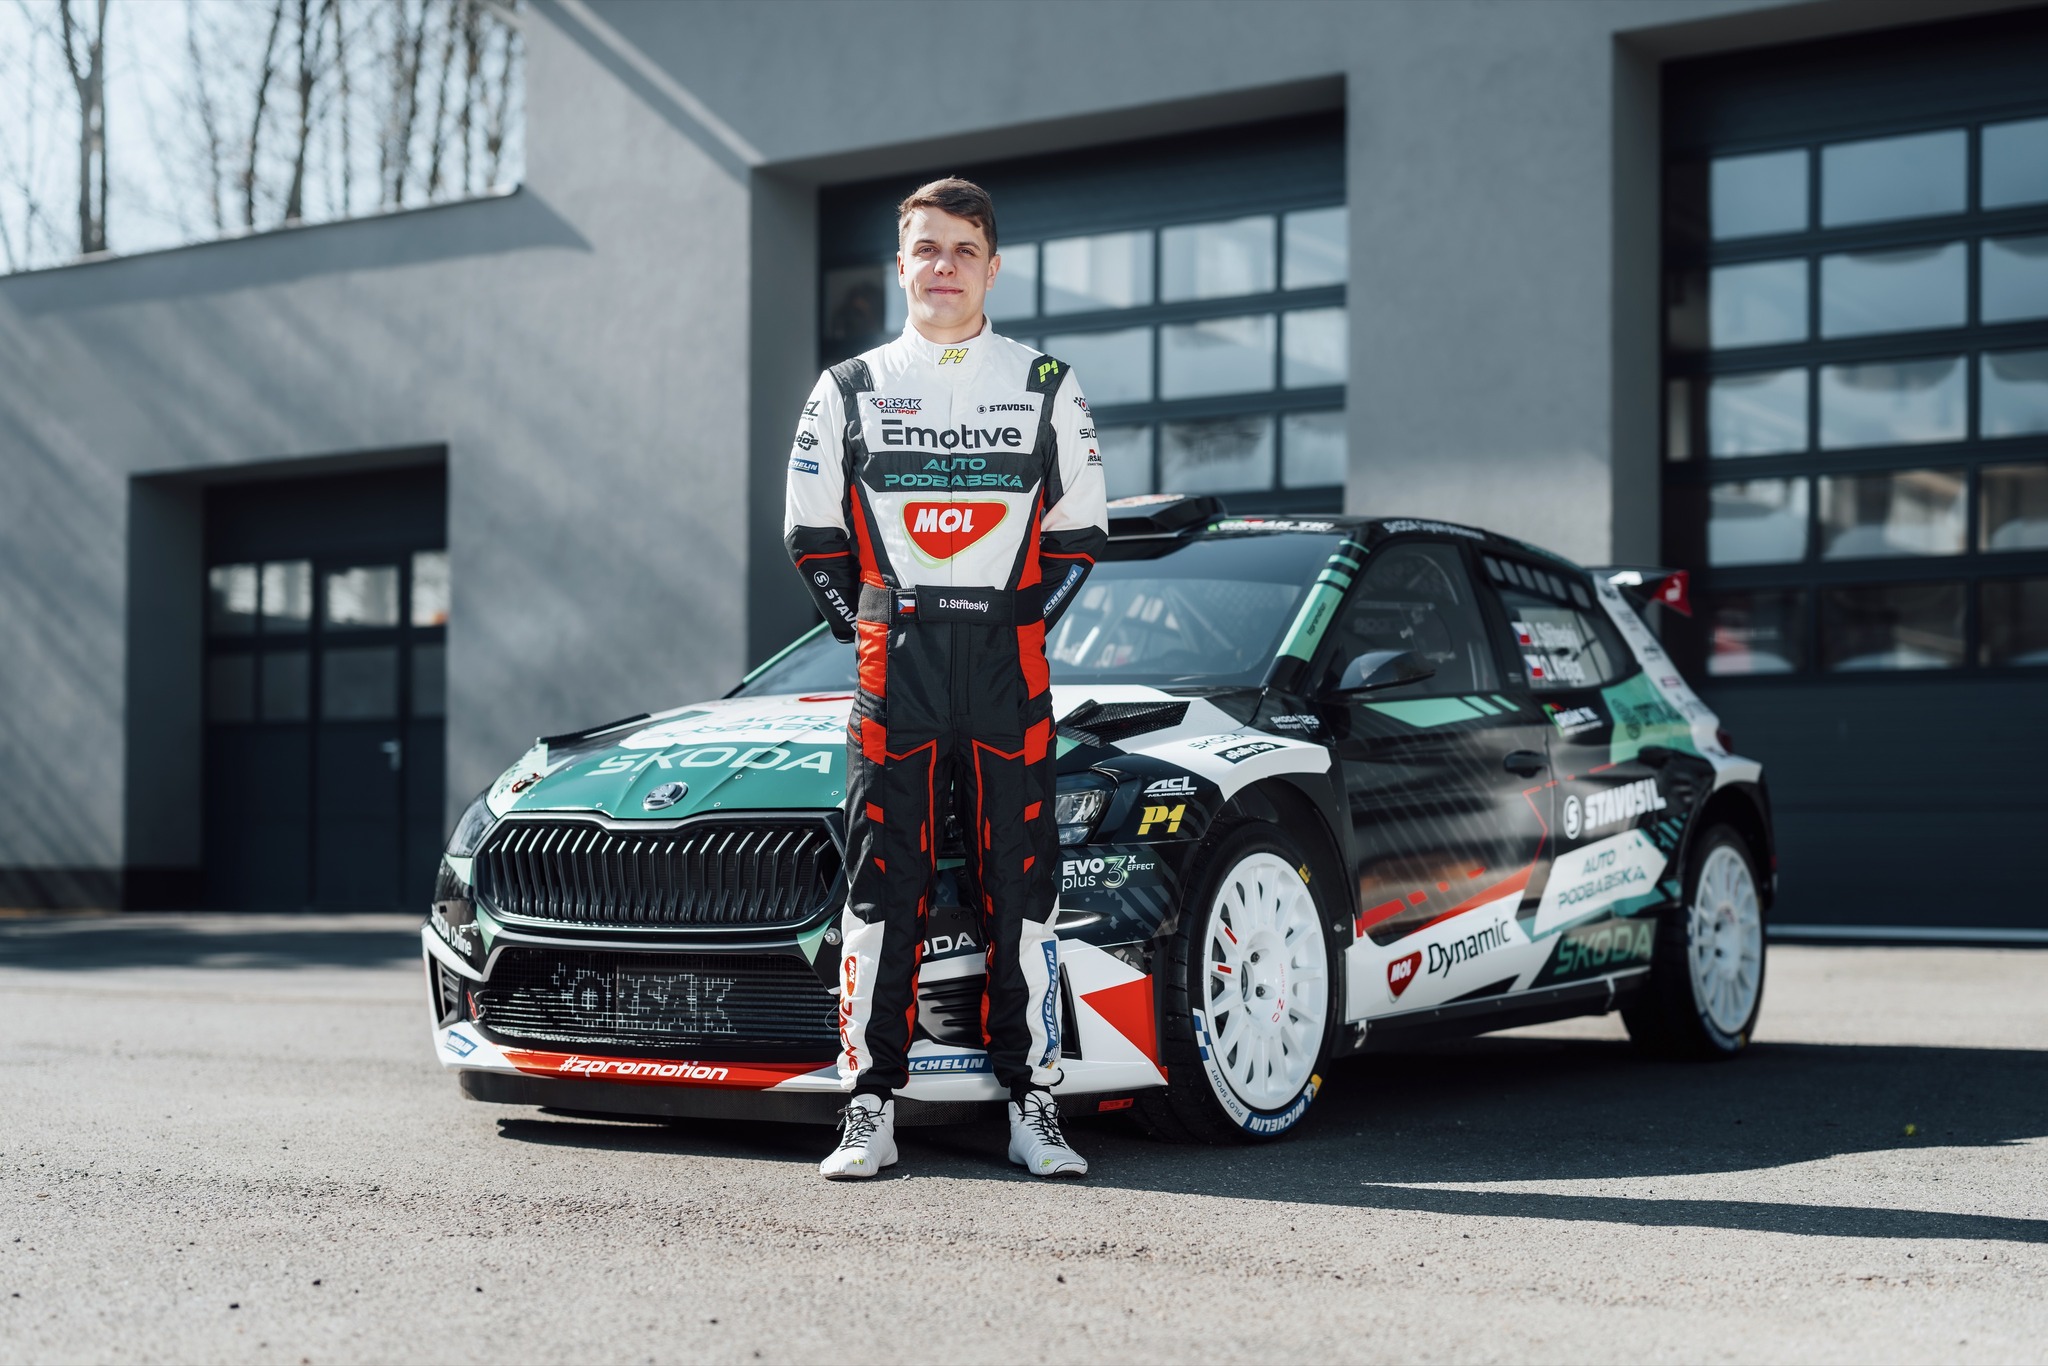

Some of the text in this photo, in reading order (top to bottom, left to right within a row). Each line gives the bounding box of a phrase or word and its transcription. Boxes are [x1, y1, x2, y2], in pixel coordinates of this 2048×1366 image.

[989, 404, 1035, 412] STAVOSIL
[881, 419, 1022, 449] Emotive
[922, 458, 987, 472] AUTO
[884, 473, 1024, 488] PODBABSKA
[913, 508, 974, 533] MOL
[1043, 569, 1078, 615] ICHELIN
[1143, 776, 1198, 794] ACL
[1584, 778, 1667, 831] STAVOSIL
[1137, 804, 1186, 835] P1
[1062, 858, 1105, 876] EVO
[1127, 862, 1155, 871] EFFECT
[1582, 849, 1616, 876] AUTO
[1061, 874, 1096, 892] plus
[1390, 917, 1512, 983] MOL Dynamic
[1045, 949, 1059, 1042] MICHELIN
[558, 1056, 729, 1081] #zpromotion
[908, 1058, 985, 1071] ICHELIN
[1211, 1069, 1243, 1119] PILOT SPORT
[1249, 1099, 1306, 1132] MICHELIN
